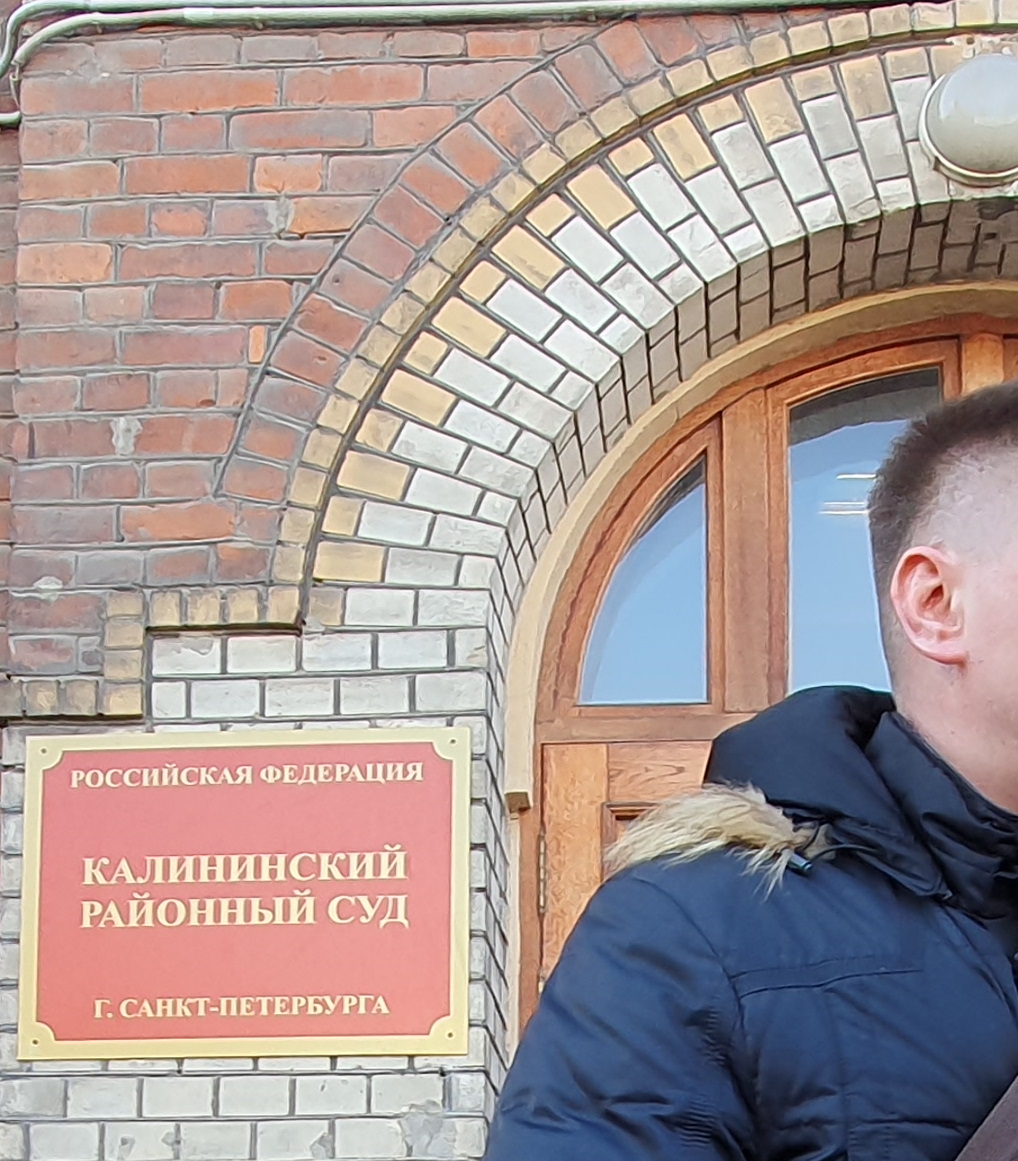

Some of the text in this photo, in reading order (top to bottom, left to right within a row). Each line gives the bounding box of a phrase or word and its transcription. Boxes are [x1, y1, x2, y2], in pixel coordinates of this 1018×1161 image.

[70, 762, 424, 788] РОССИЙСКАЯ ФЕДЕРАЦИЯ
[81, 844, 408, 886] КАЛИНИНСКИЙ
[79, 889, 409, 929] РАЙОННЫЙ СУД
[93, 995, 390, 1019] Г. САНКТ-ПЕТЕРБУРГА
